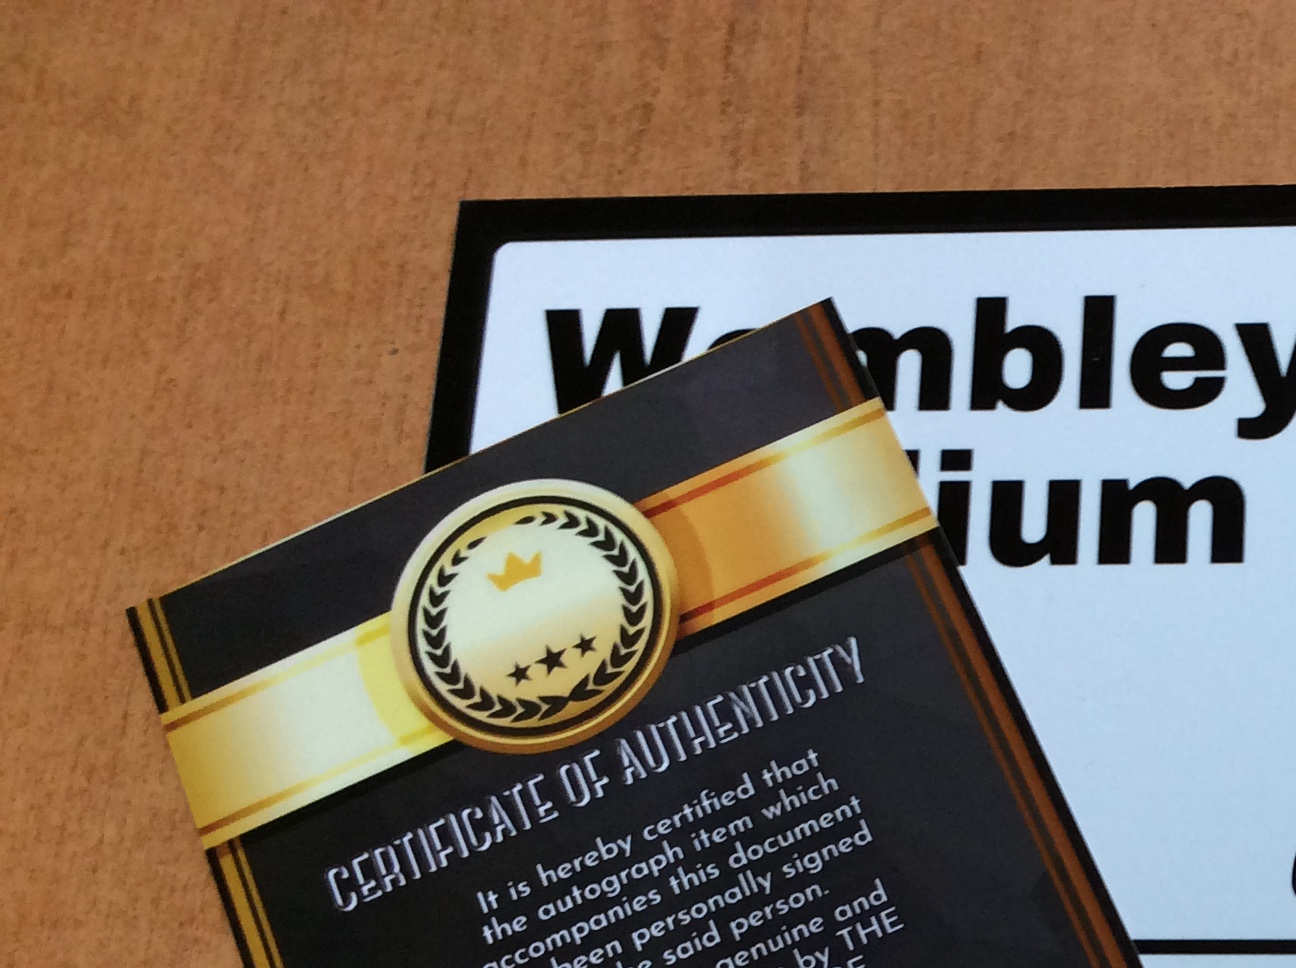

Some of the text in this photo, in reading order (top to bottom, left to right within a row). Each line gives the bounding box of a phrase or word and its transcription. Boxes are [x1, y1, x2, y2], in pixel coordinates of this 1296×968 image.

[326, 635, 866, 913] CERTIFICATE OF AUTHENTICITY
[475, 747, 820, 915] It is hereby certified that
[481, 770, 840, 946] the autograph item which
[630, 868, 773, 953] personally
[780, 817, 874, 880] signed
[667, 862, 721, 896] this
[727, 794, 863, 870] document
[833, 876, 889, 923] and
[661, 918, 723, 967] said
[728, 883, 831, 943] person.
[834, 905, 906, 952] THE
